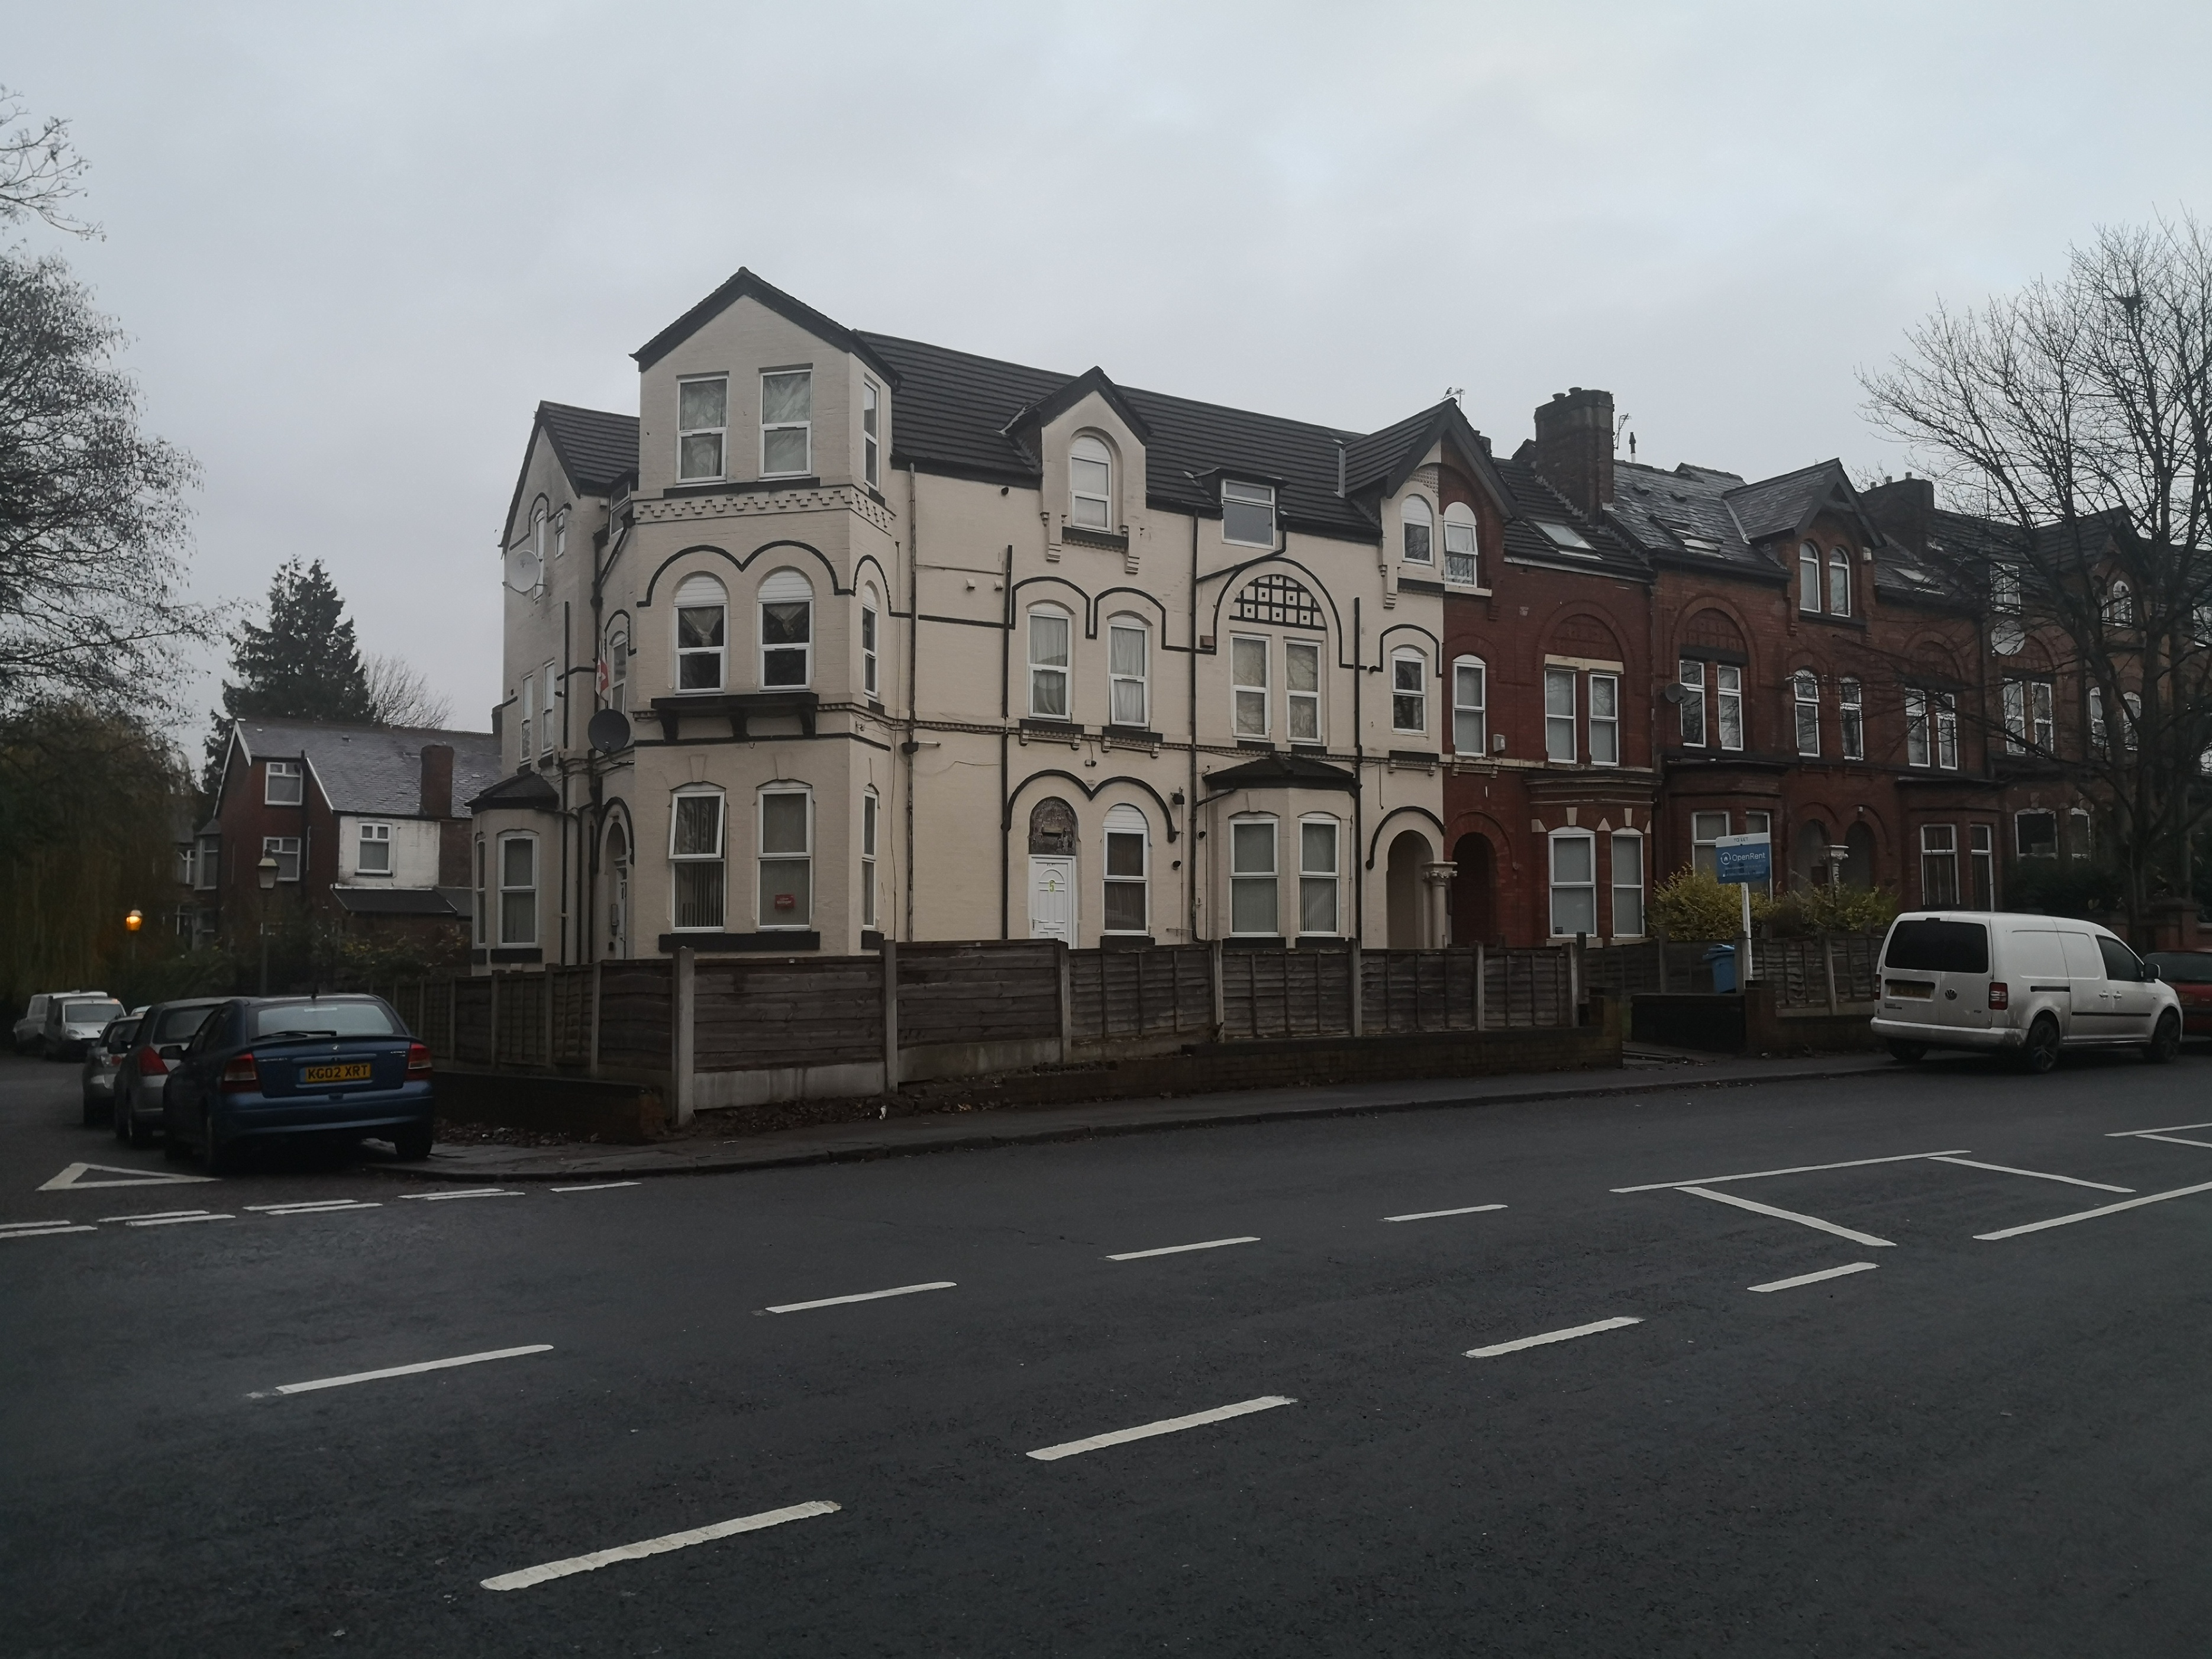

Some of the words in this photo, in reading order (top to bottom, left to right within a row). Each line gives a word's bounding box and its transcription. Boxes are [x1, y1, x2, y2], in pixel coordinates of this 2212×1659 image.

[1732, 852, 1766, 862] OpenRent
[1049, 880, 1054, 892] 5
[308, 1067, 341, 1080] KG02
[345, 1064, 368, 1077] XRT
